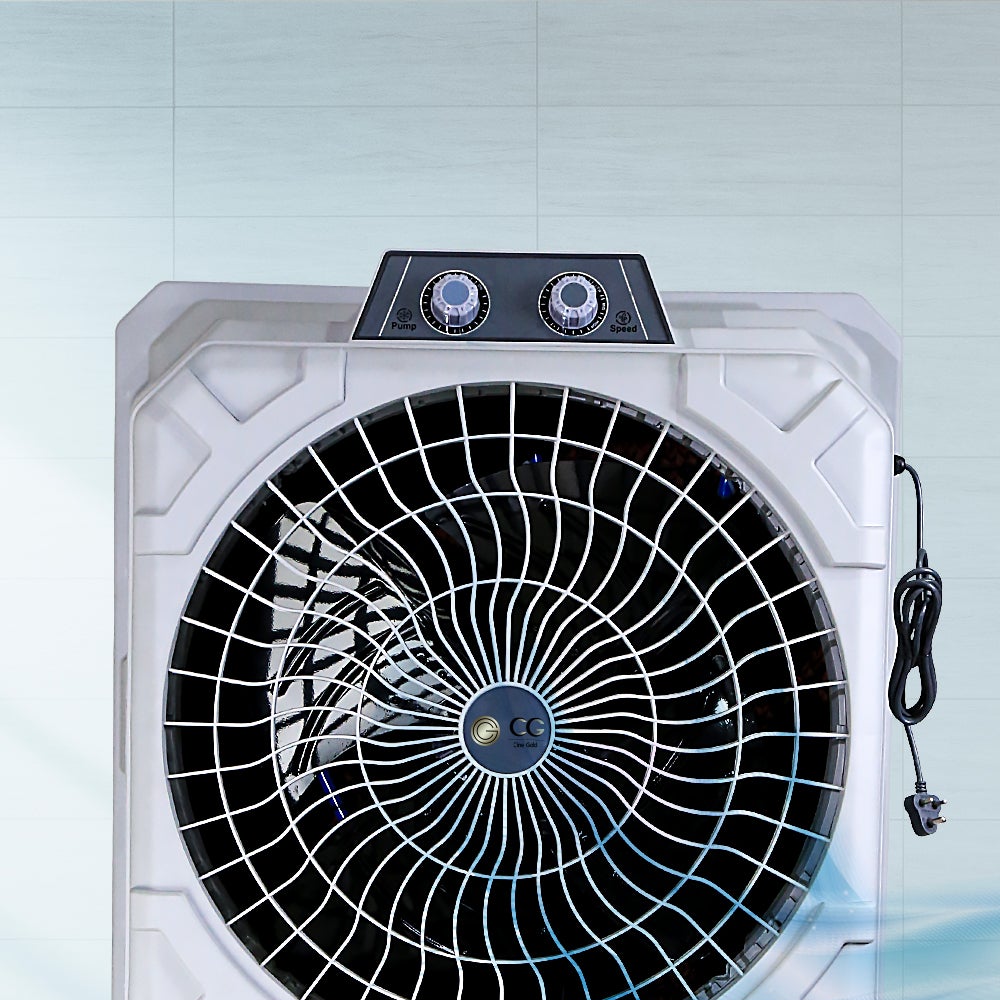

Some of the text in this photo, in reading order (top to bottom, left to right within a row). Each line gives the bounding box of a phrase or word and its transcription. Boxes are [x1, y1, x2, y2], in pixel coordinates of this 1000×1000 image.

[391, 322, 417, 331] Pump
[610, 324, 638, 333] Speed
[510, 717, 545, 737] CG
